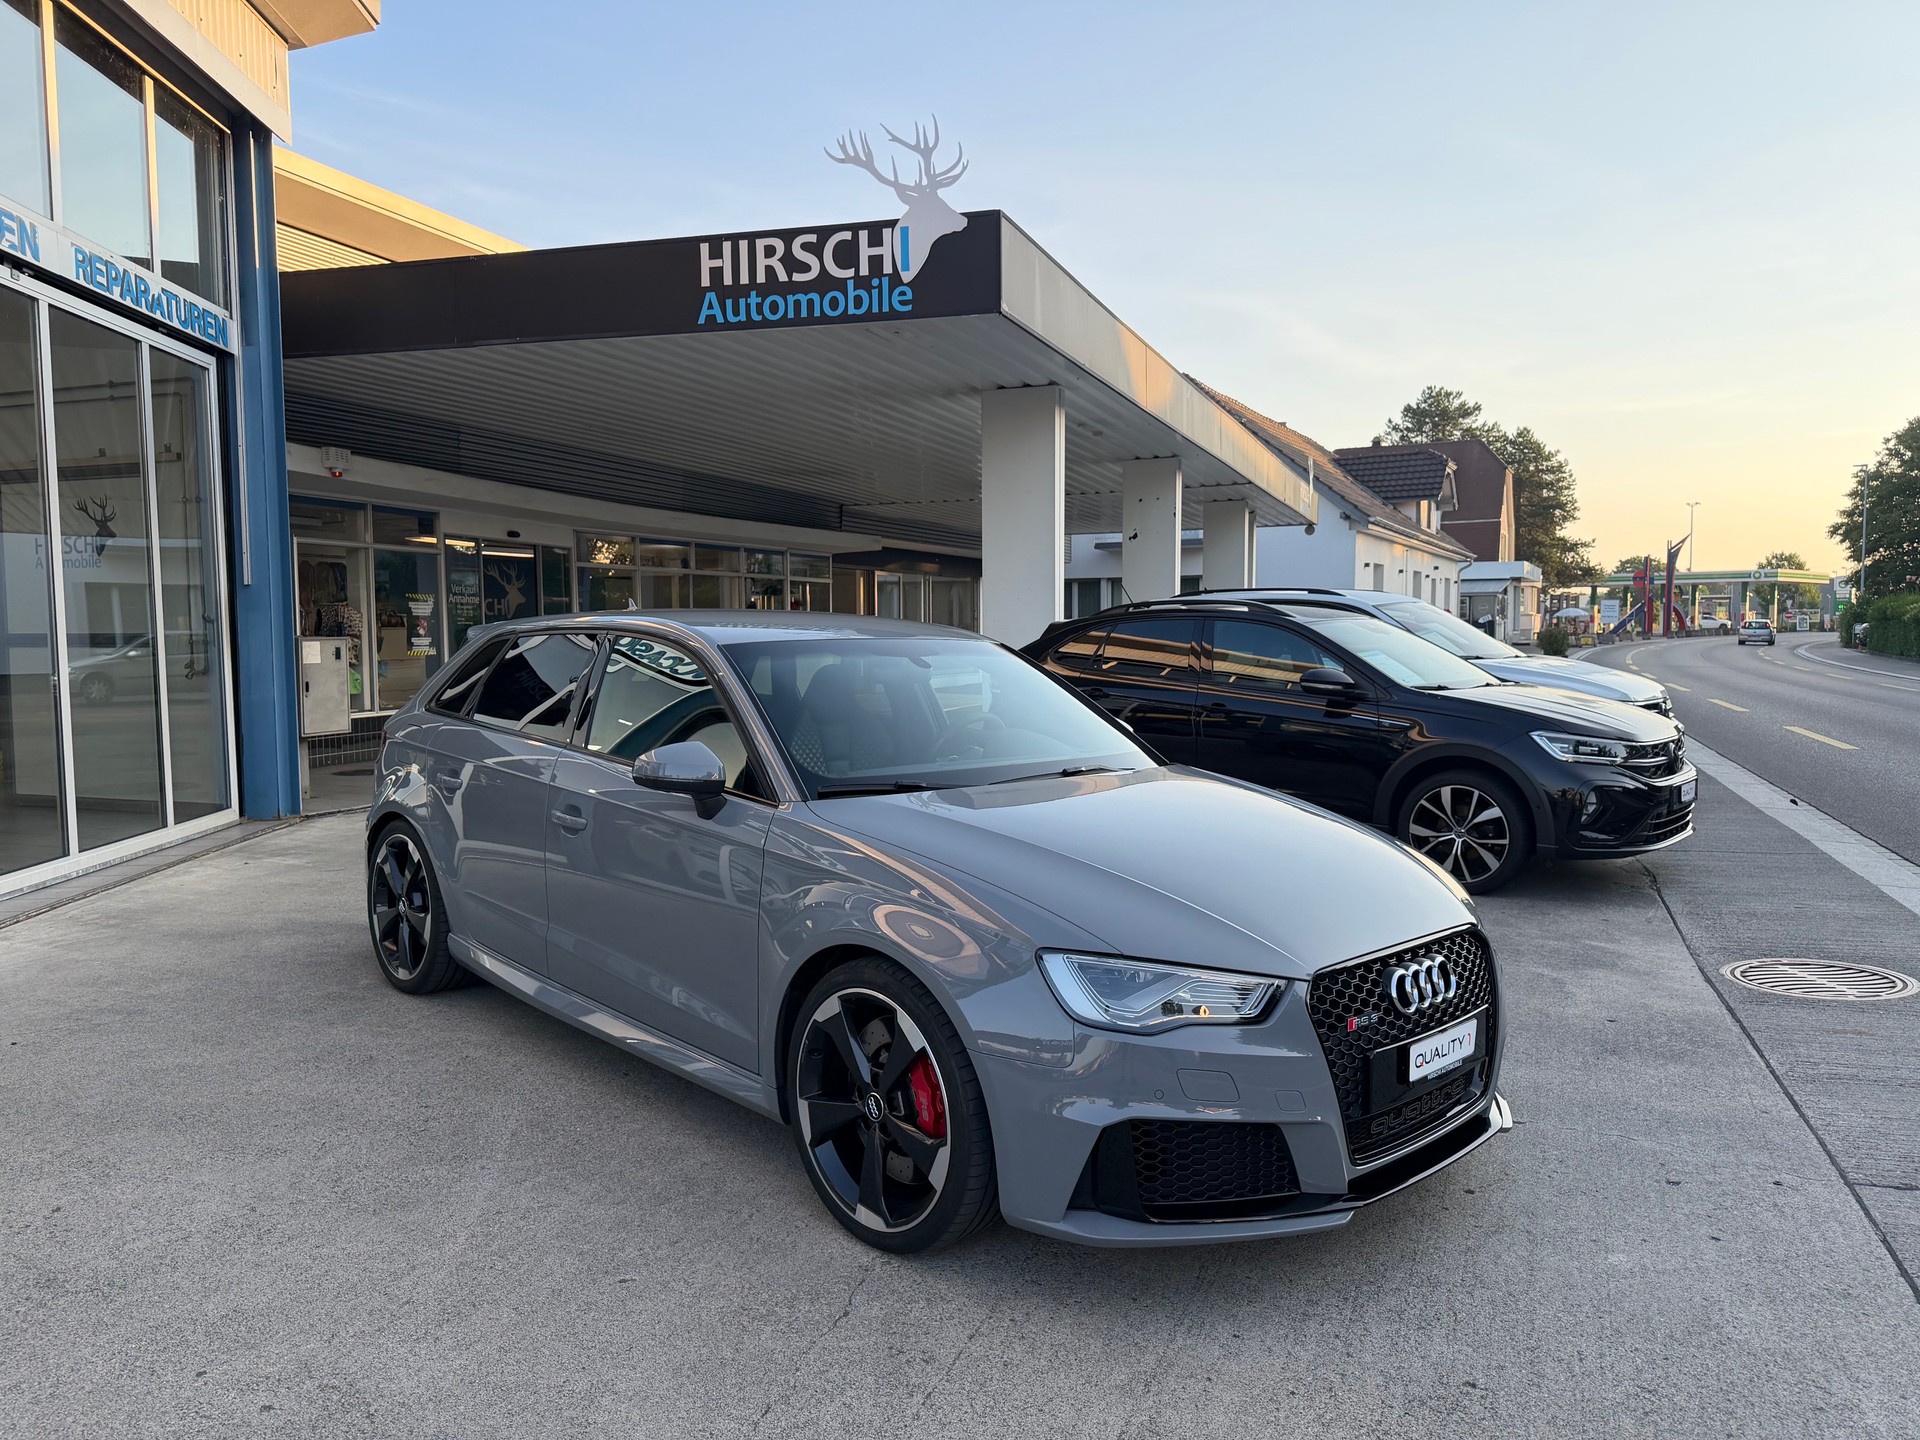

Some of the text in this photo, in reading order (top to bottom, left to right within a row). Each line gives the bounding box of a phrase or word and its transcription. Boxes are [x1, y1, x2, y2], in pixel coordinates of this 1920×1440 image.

[700, 225, 911, 287] HIRSCHI
[72, 244, 229, 349] REPARATUREN
[697, 276, 913, 325] Automobile
[1414, 1032, 1472, 1069] QUALITY 1
[1370, 1077, 1466, 1135] quattro
